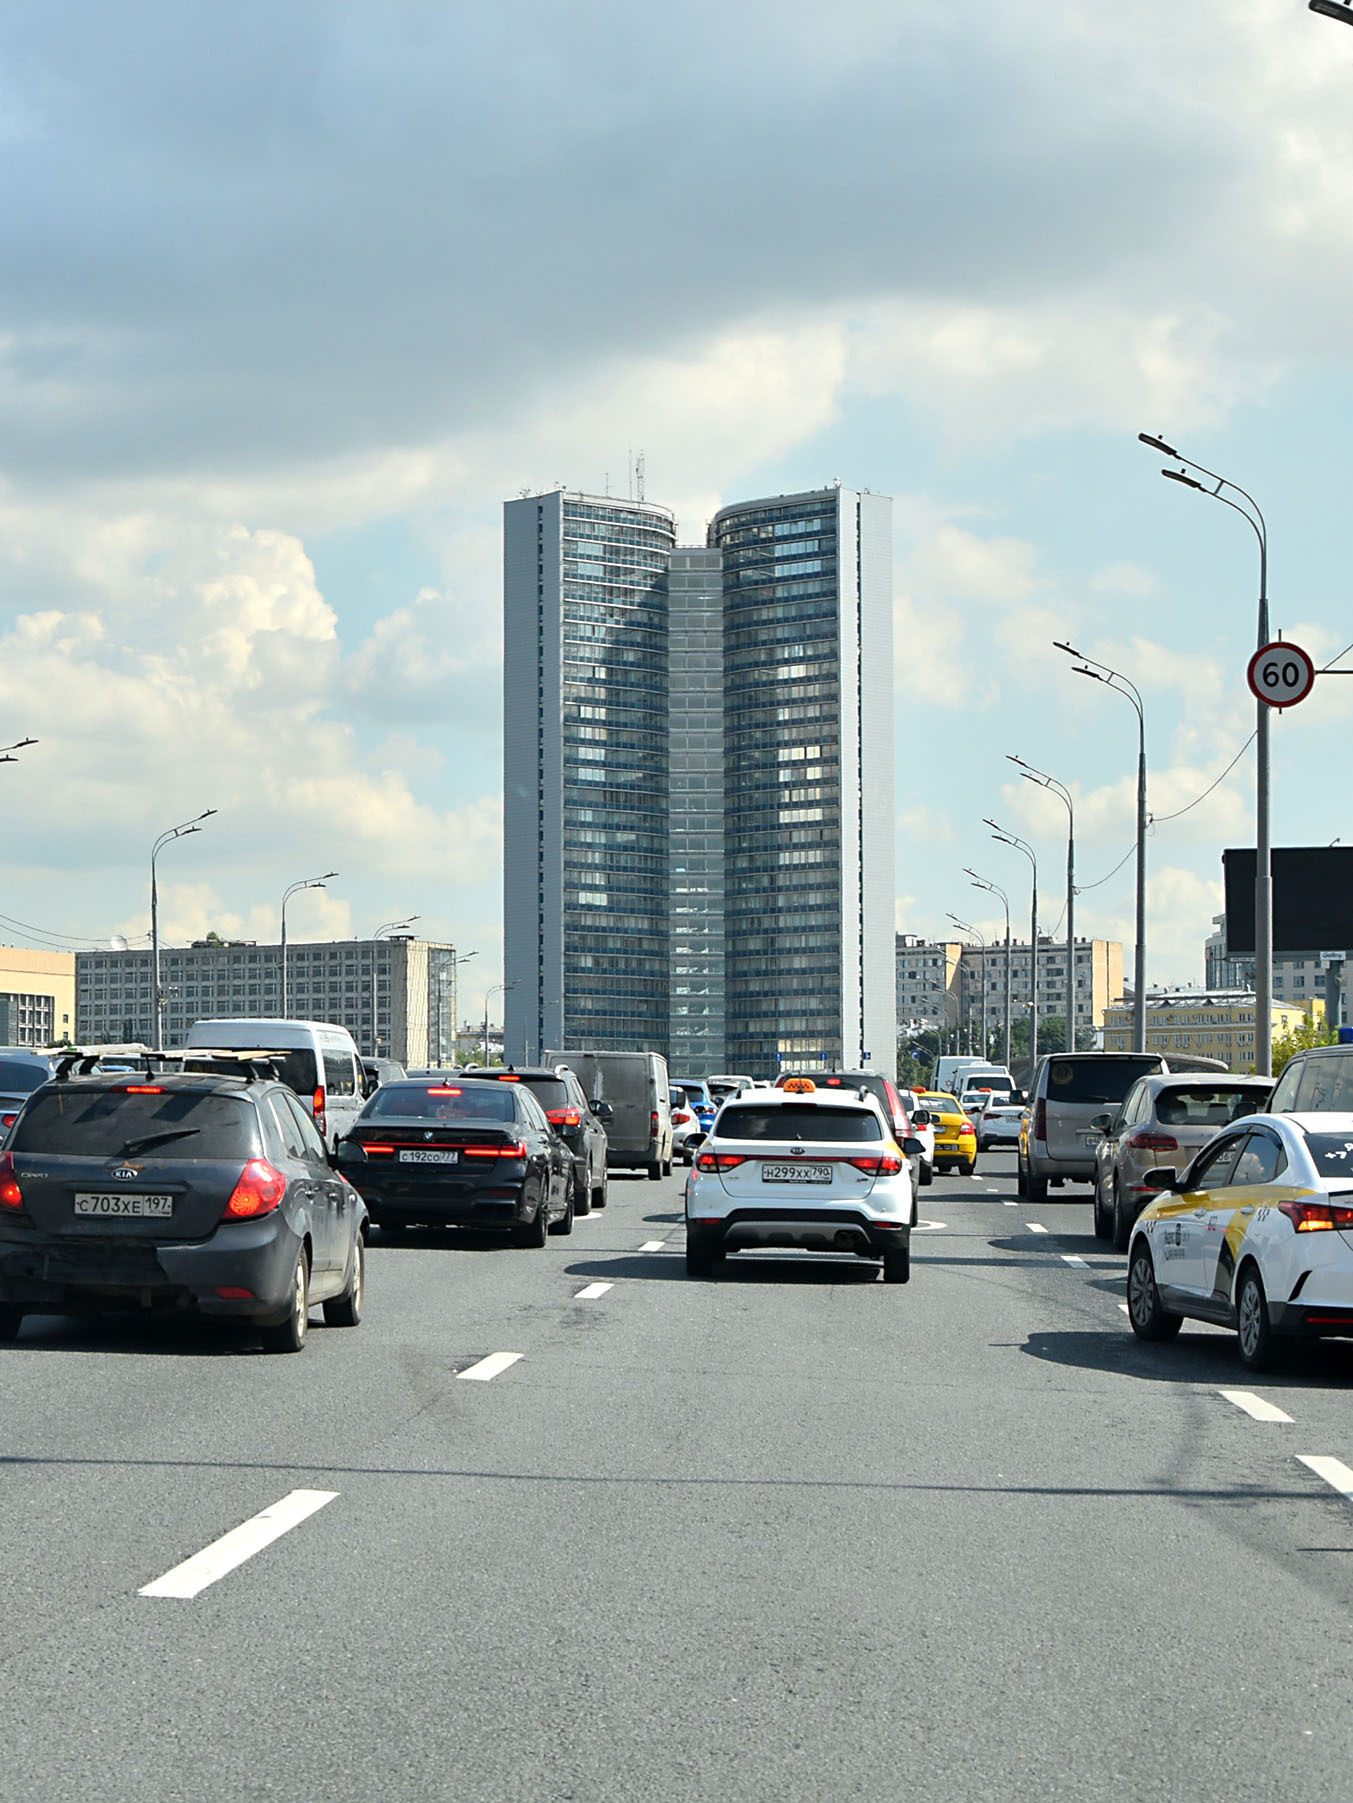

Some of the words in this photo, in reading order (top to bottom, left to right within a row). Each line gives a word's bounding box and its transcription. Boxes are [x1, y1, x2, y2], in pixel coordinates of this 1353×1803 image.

[1262, 662, 1299, 687] 60
[115, 1169, 133, 1179] KIA
[766, 1167, 809, 1178] Н299ХХ
[813, 1167, 828, 1176] 790
[79, 1197, 141, 1214] С703ХЕ
[146, 1197, 166, 1210] 197
